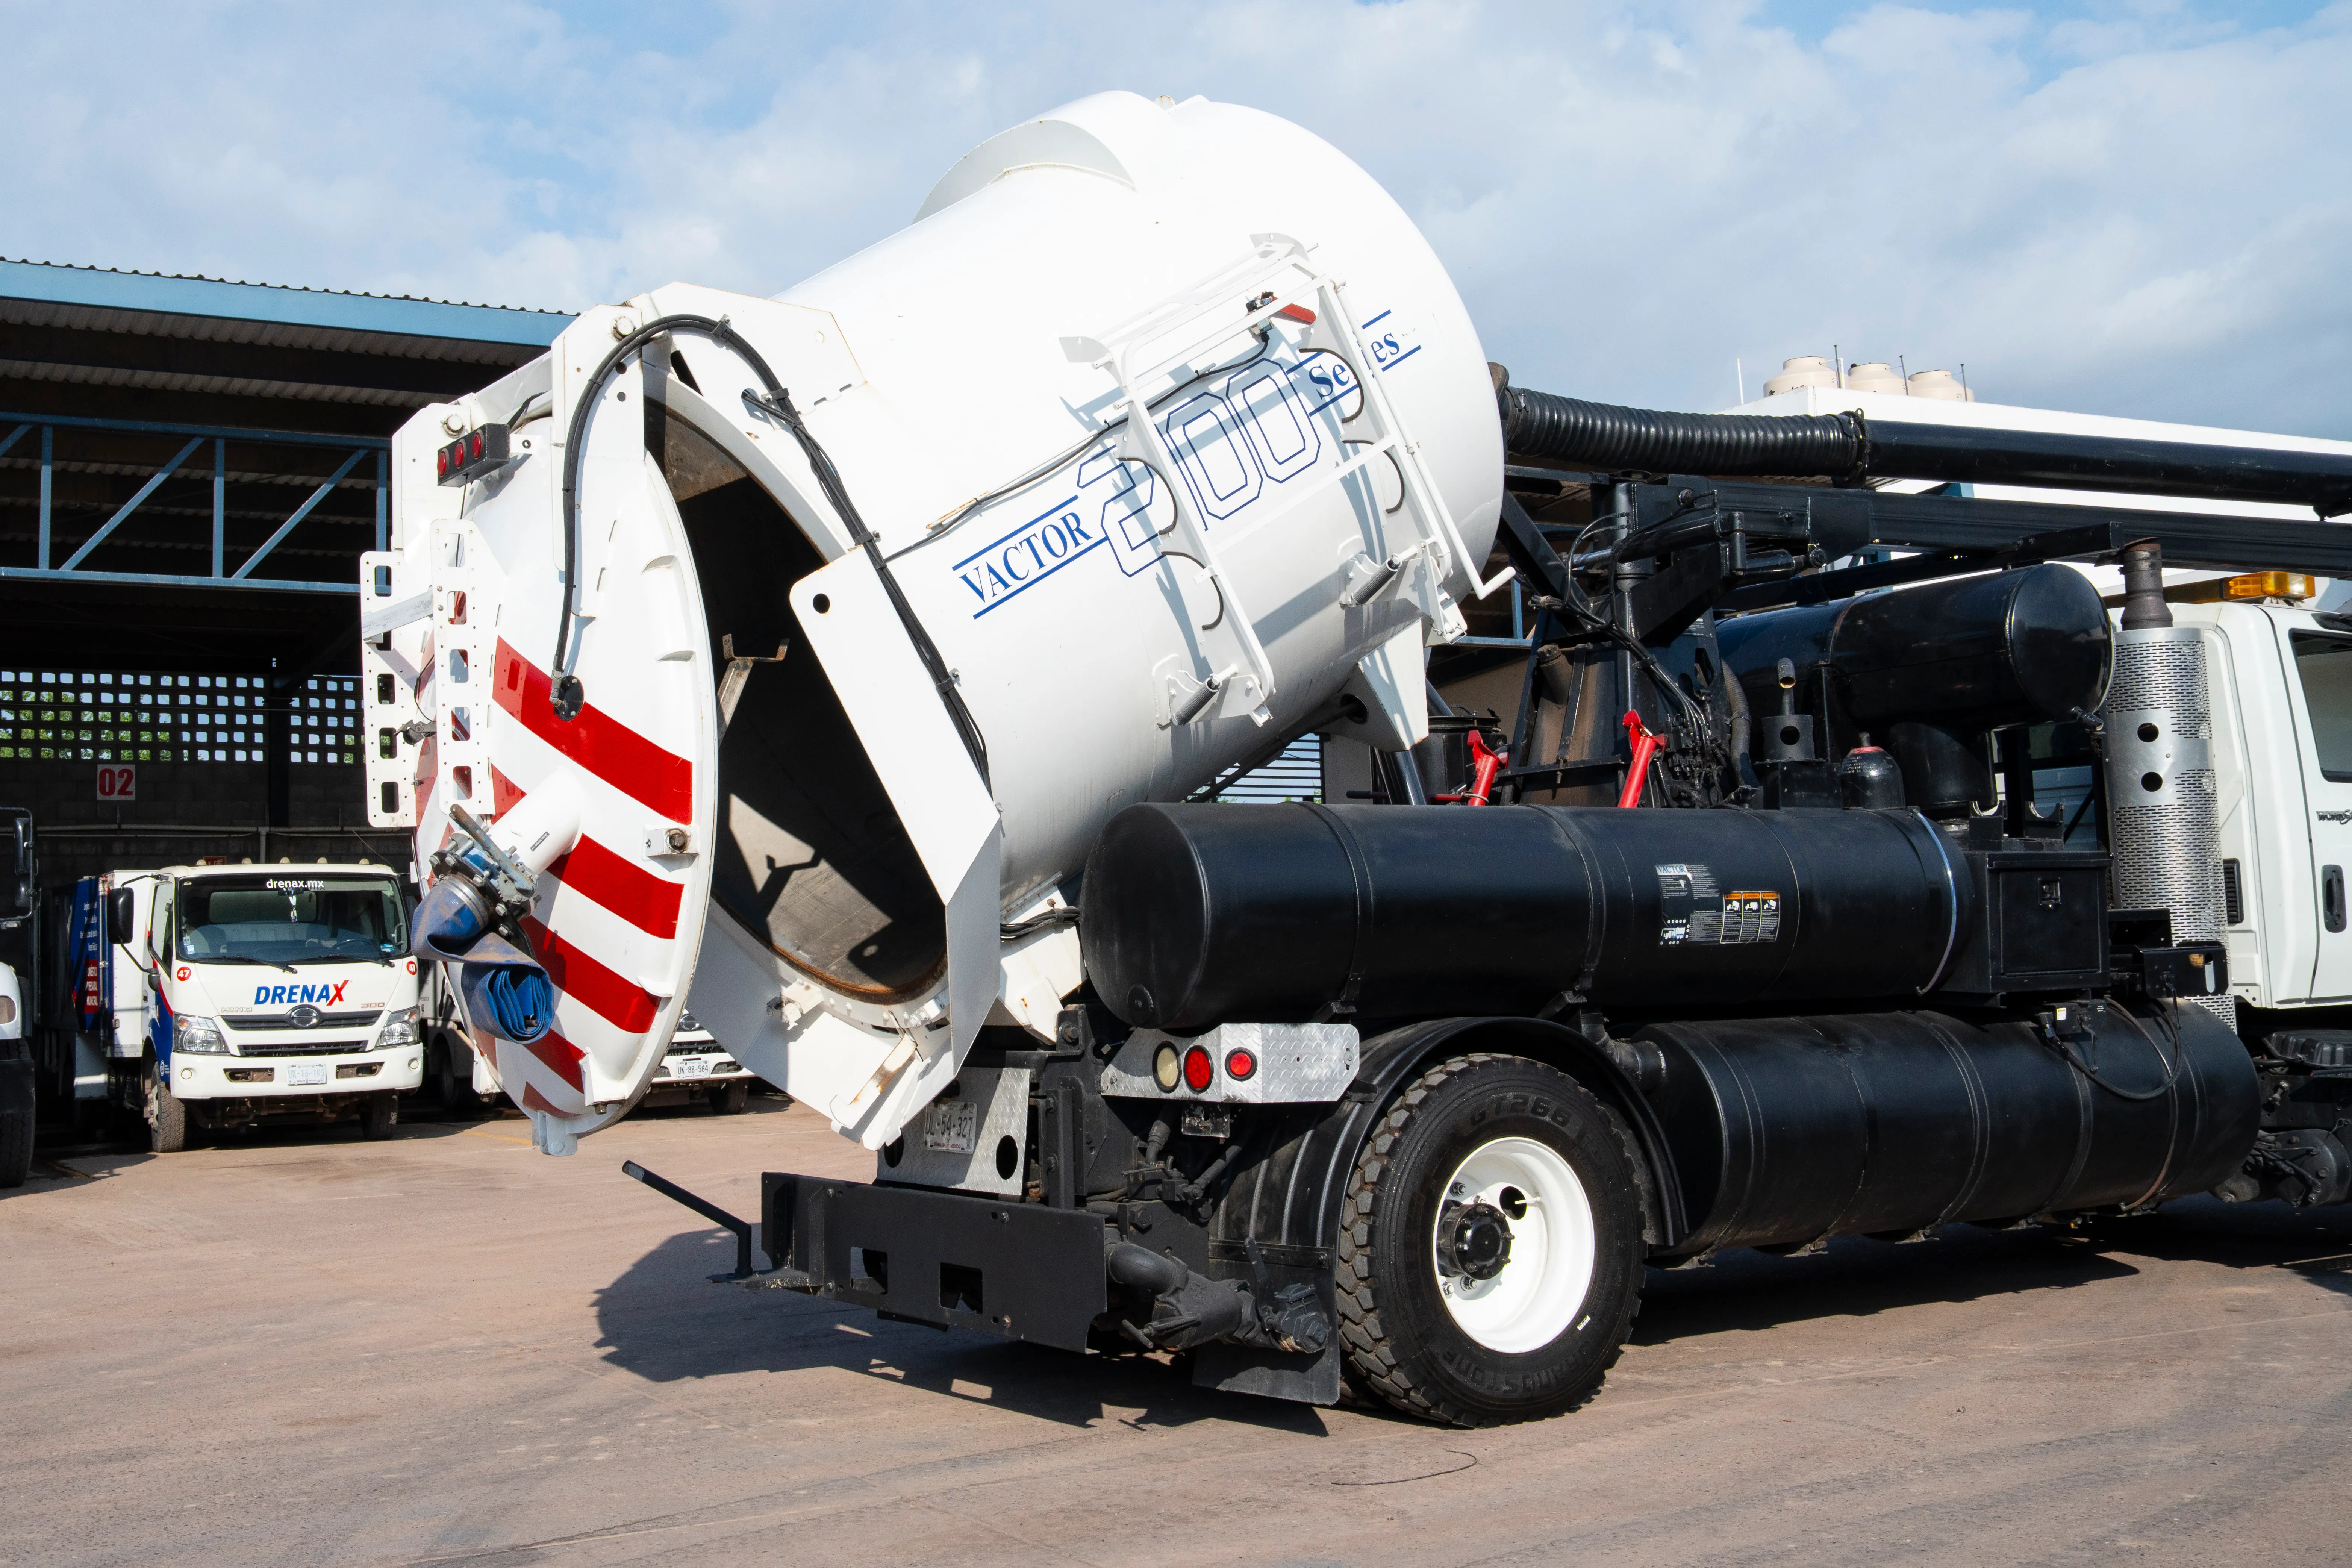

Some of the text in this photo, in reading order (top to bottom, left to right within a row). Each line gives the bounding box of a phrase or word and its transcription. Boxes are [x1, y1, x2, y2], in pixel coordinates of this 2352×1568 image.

[959, 332, 1399, 603] VACTOR 200 Sees
[98, 768, 134, 796] 02
[266, 879, 324, 888] drenax.mx
[255, 980, 348, 1006] DRENAX
[288, 1069, 325, 1078] UK-16-195
[678, 1065, 708, 1074] UK-88-584
[925, 1113, 973, 1138] UL-54-327
